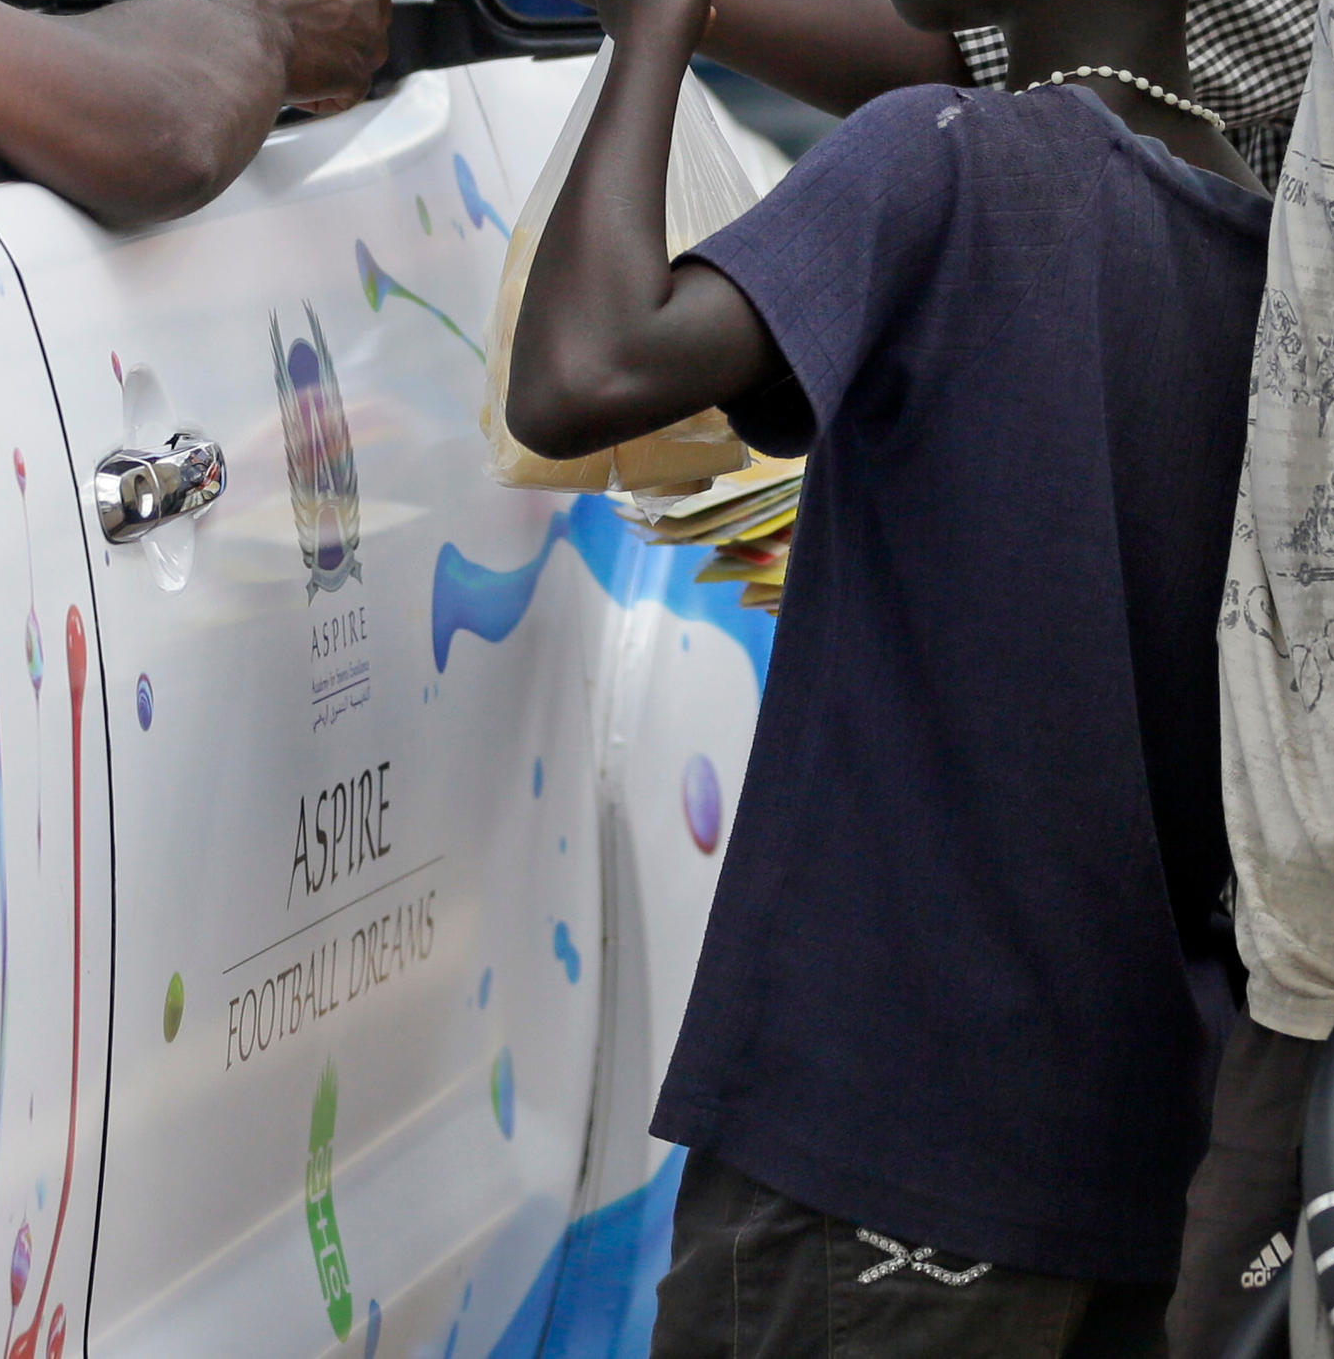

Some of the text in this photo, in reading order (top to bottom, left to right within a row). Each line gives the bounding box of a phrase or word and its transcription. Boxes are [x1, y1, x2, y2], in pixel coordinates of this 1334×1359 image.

[310, 606, 368, 662] ASPIRE
[286, 760, 392, 911] ASPIRE
[225, 889, 436, 1072] FOOTBALL DREAMS
